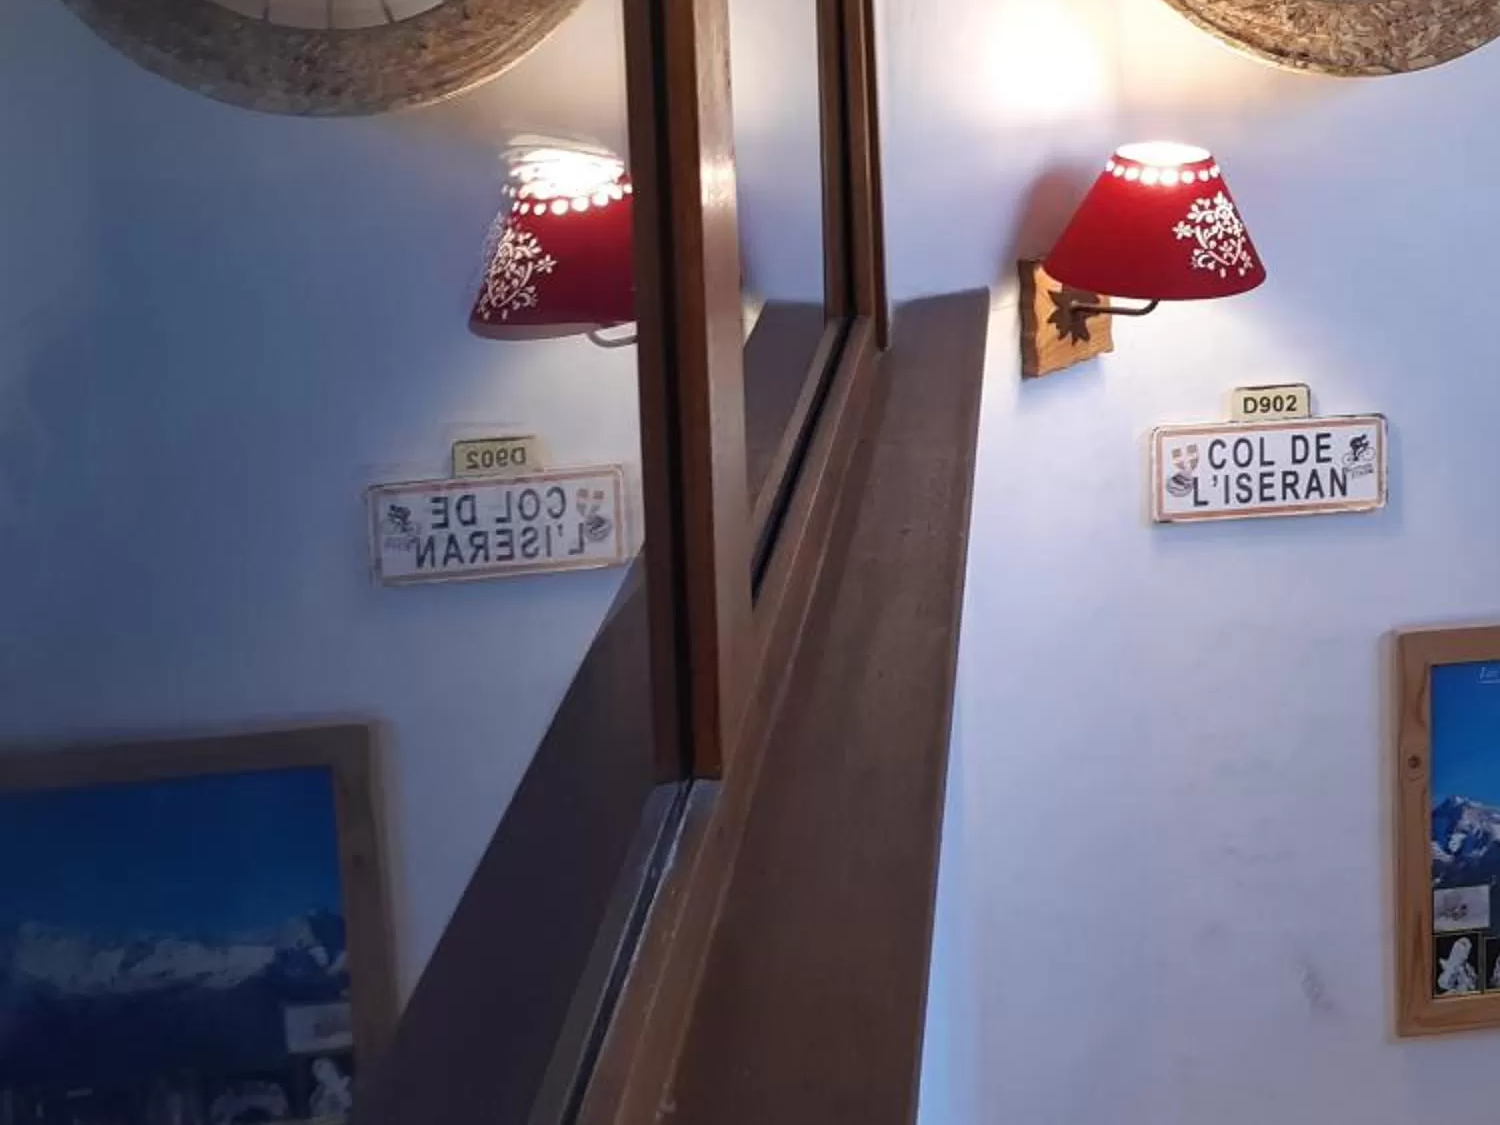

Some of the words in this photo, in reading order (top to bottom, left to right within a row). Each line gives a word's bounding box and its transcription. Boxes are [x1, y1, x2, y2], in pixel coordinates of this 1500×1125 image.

[1243, 394, 1298, 414] D902
[1208, 436, 1274, 470] COL
[1291, 433, 1333, 465] DE
[1192, 467, 1348, 507] L'ISERAN
